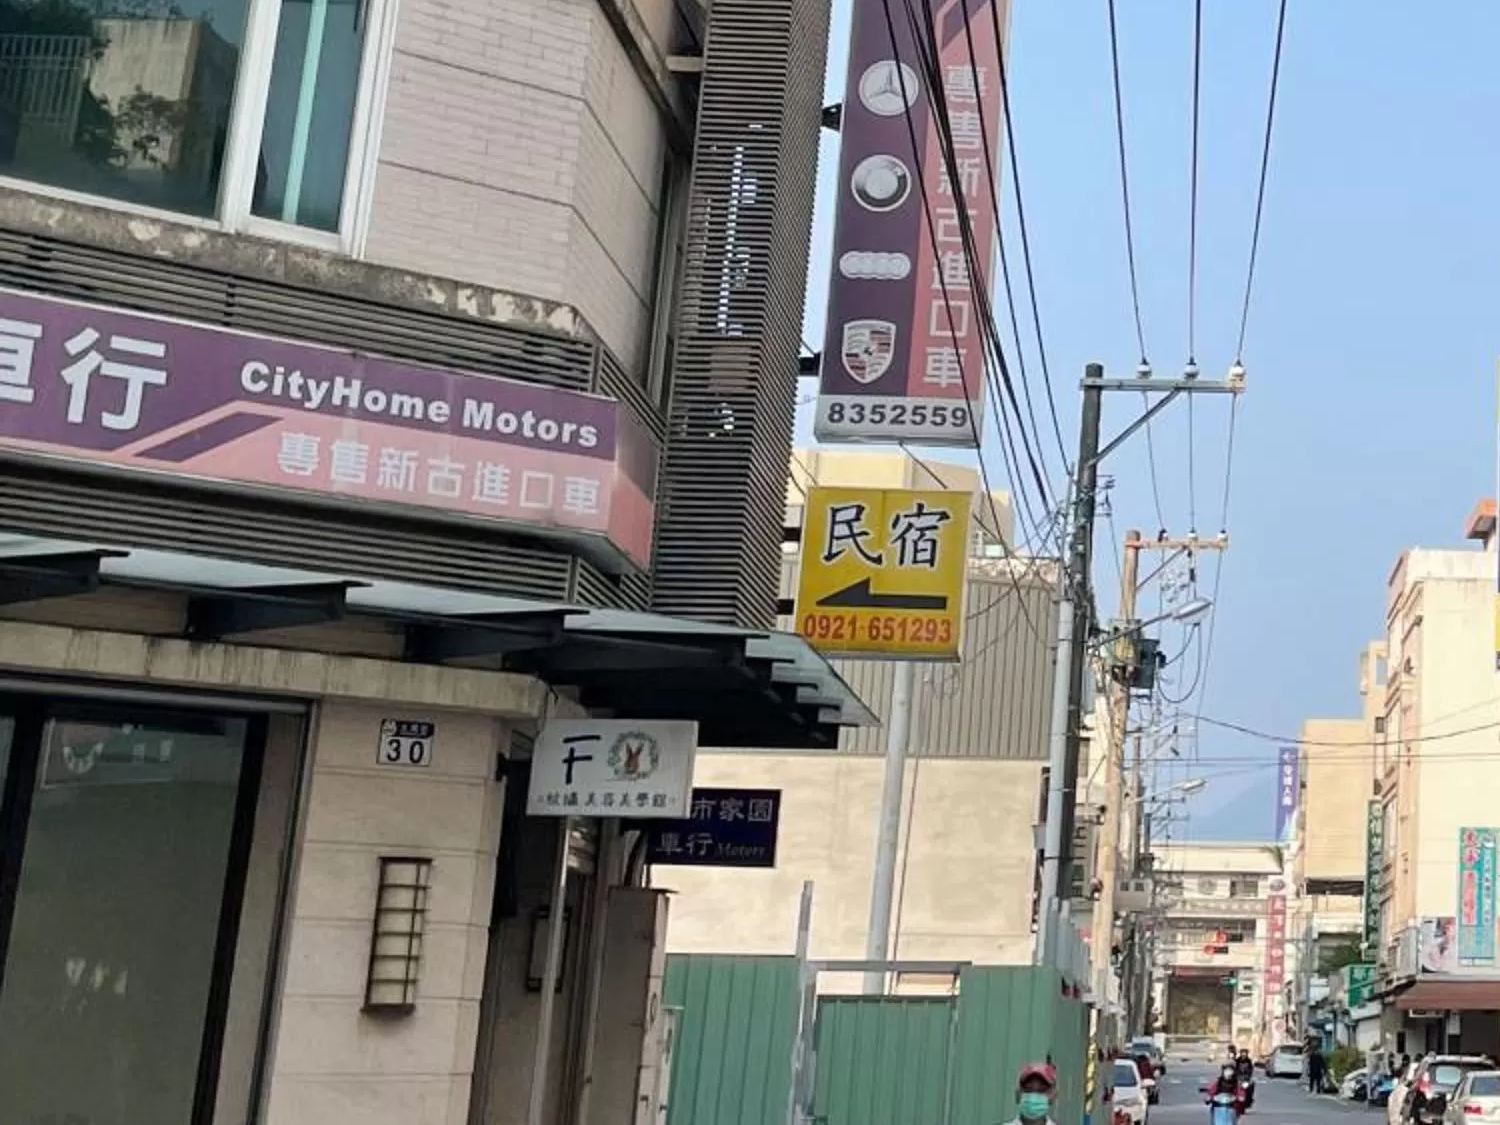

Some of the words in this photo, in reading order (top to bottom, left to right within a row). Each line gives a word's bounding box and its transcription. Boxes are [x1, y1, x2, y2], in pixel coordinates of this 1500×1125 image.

[241, 360, 452, 425] CityHome
[462, 398, 600, 449] Motors
[827, 401, 968, 428] 8352559
[277, 431, 602, 517] 專售新古進口車
[822, 502, 951, 568] 民宿
[387, 738, 425, 764] 30
